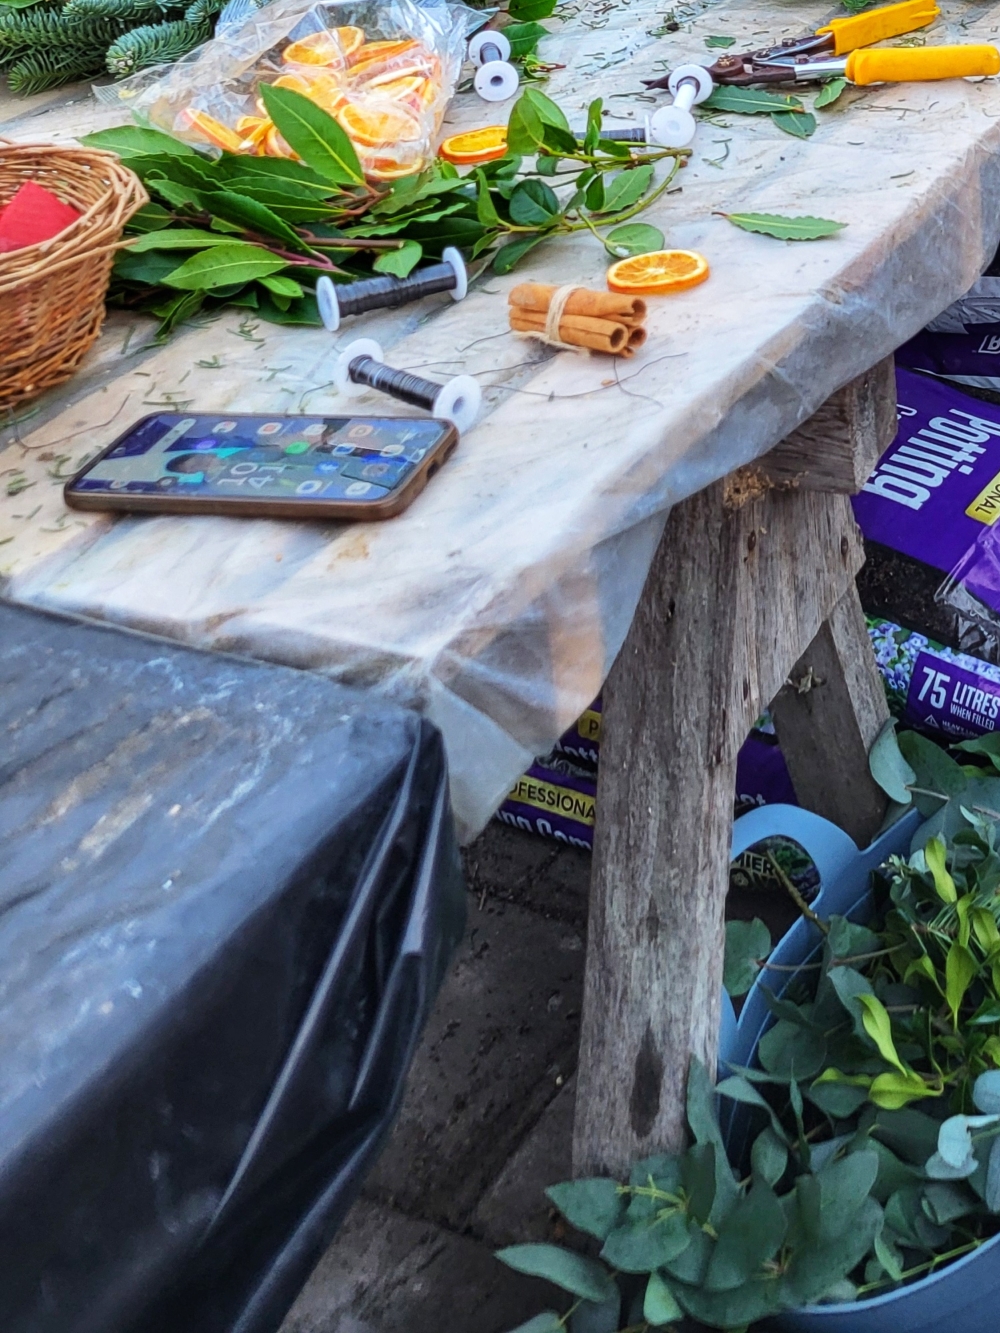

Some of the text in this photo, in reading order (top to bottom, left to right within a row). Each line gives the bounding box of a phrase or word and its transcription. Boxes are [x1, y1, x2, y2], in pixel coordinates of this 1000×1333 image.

[918, 666, 951, 709] 75
[950, 703, 995, 731] WHEN FILLED
